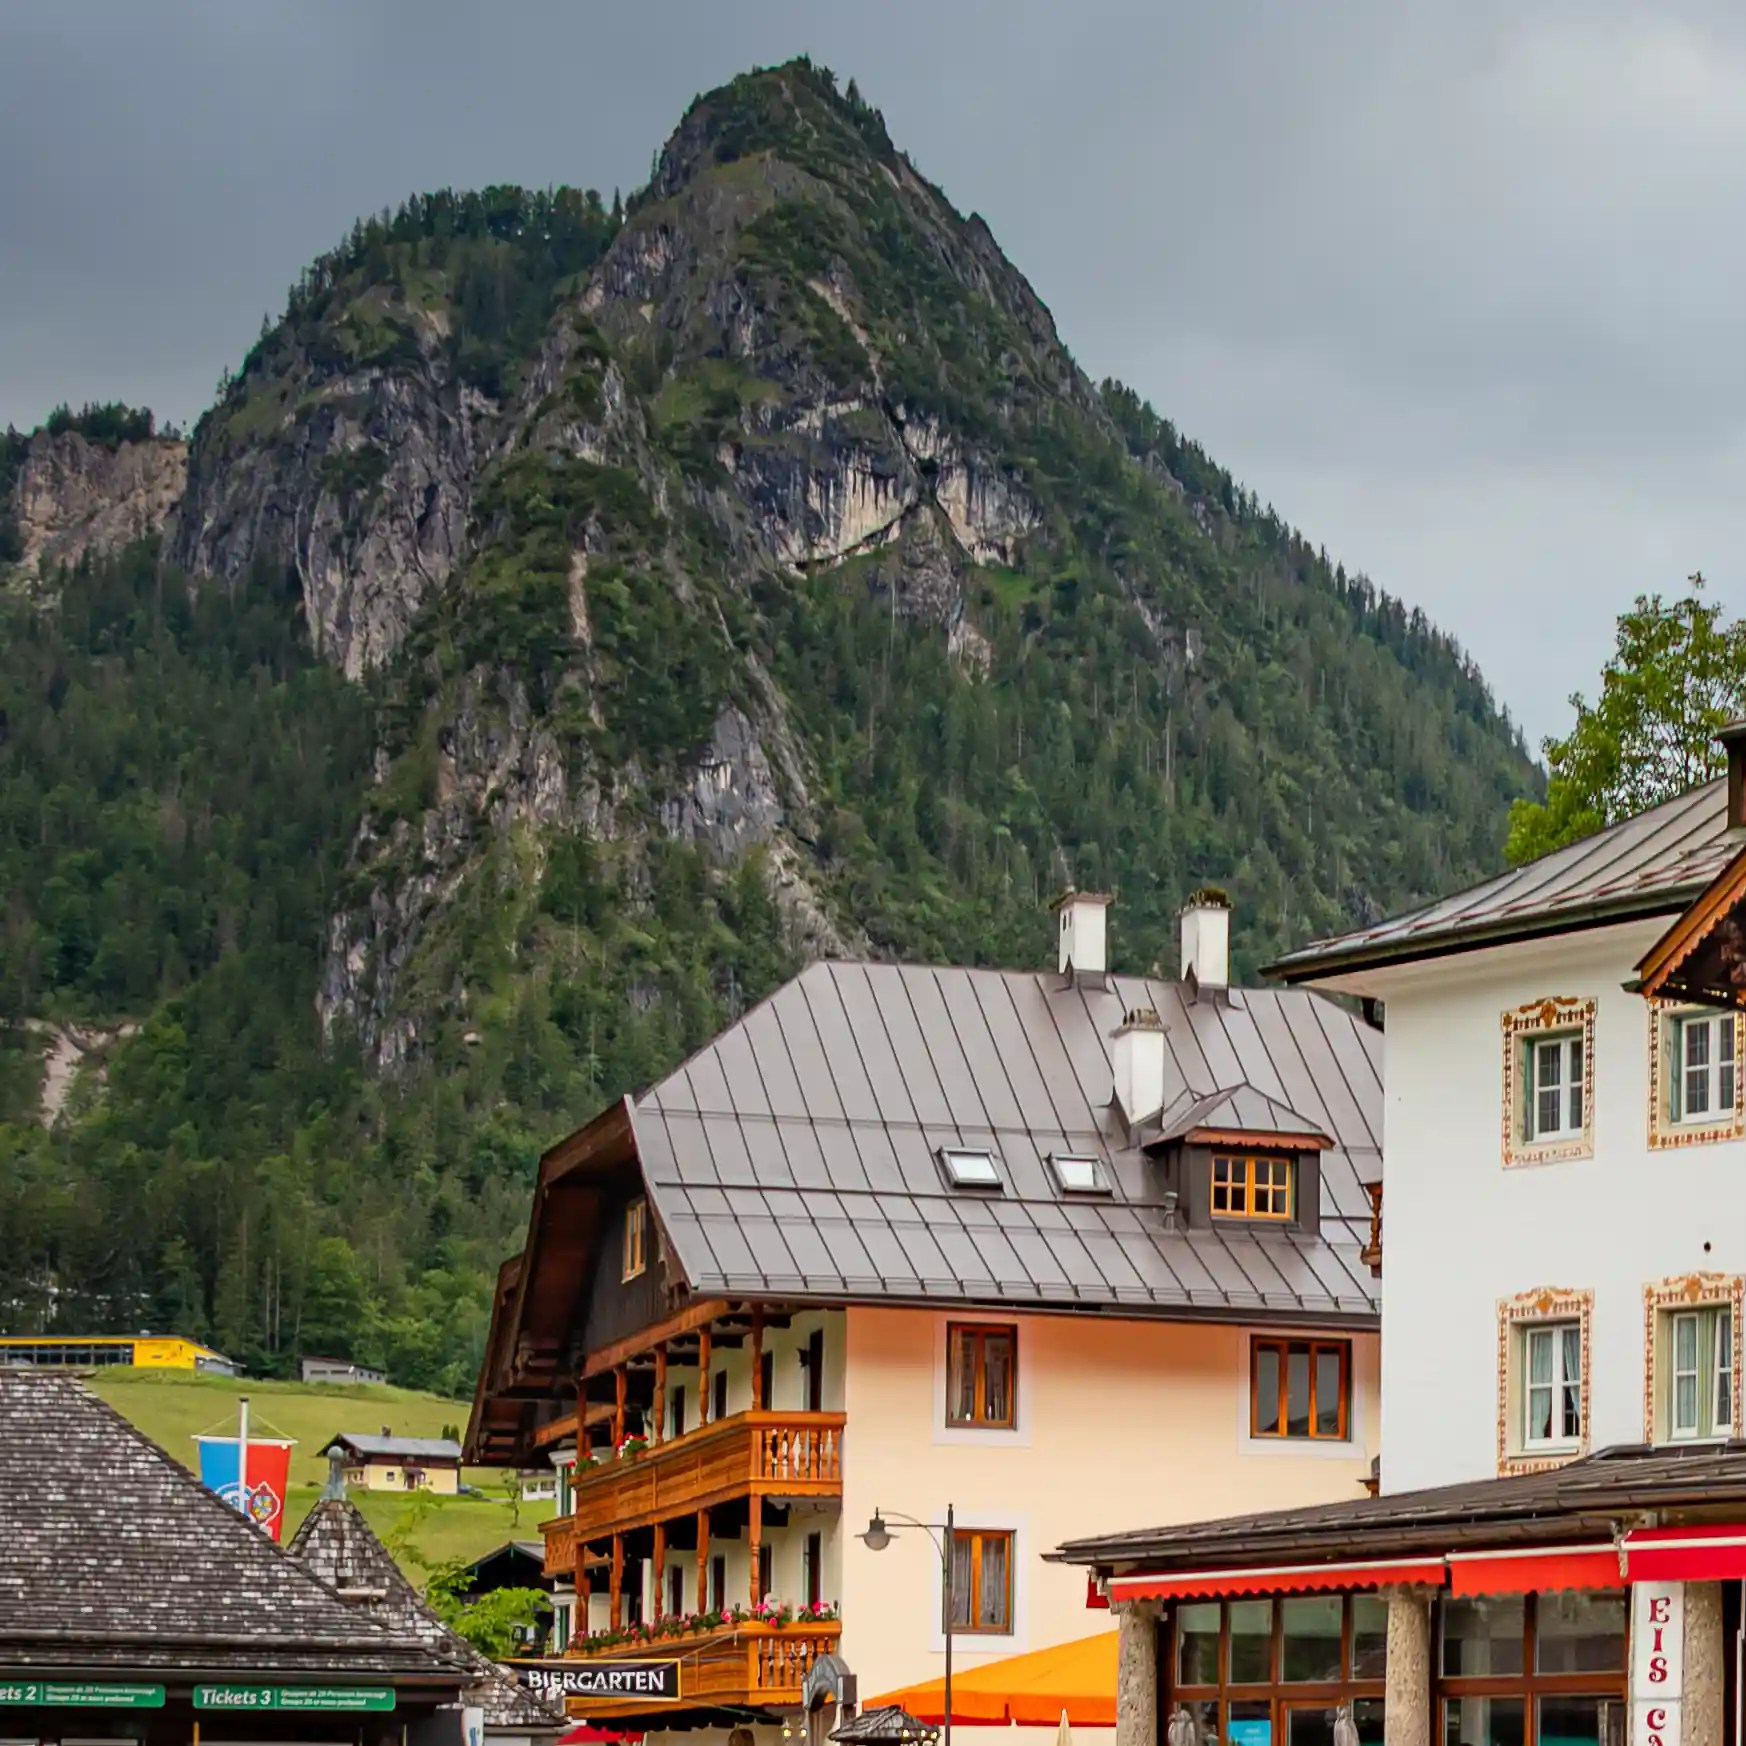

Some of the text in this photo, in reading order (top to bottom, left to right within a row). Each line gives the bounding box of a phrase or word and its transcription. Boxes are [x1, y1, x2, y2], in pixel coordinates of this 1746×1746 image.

[1648, 1596, 1671, 1684] EIS
[528, 1670, 664, 1691] BIERGARTEN
[25, 1686, 37, 1701] 2
[201, 1689, 272, 1705] Tickets 3
